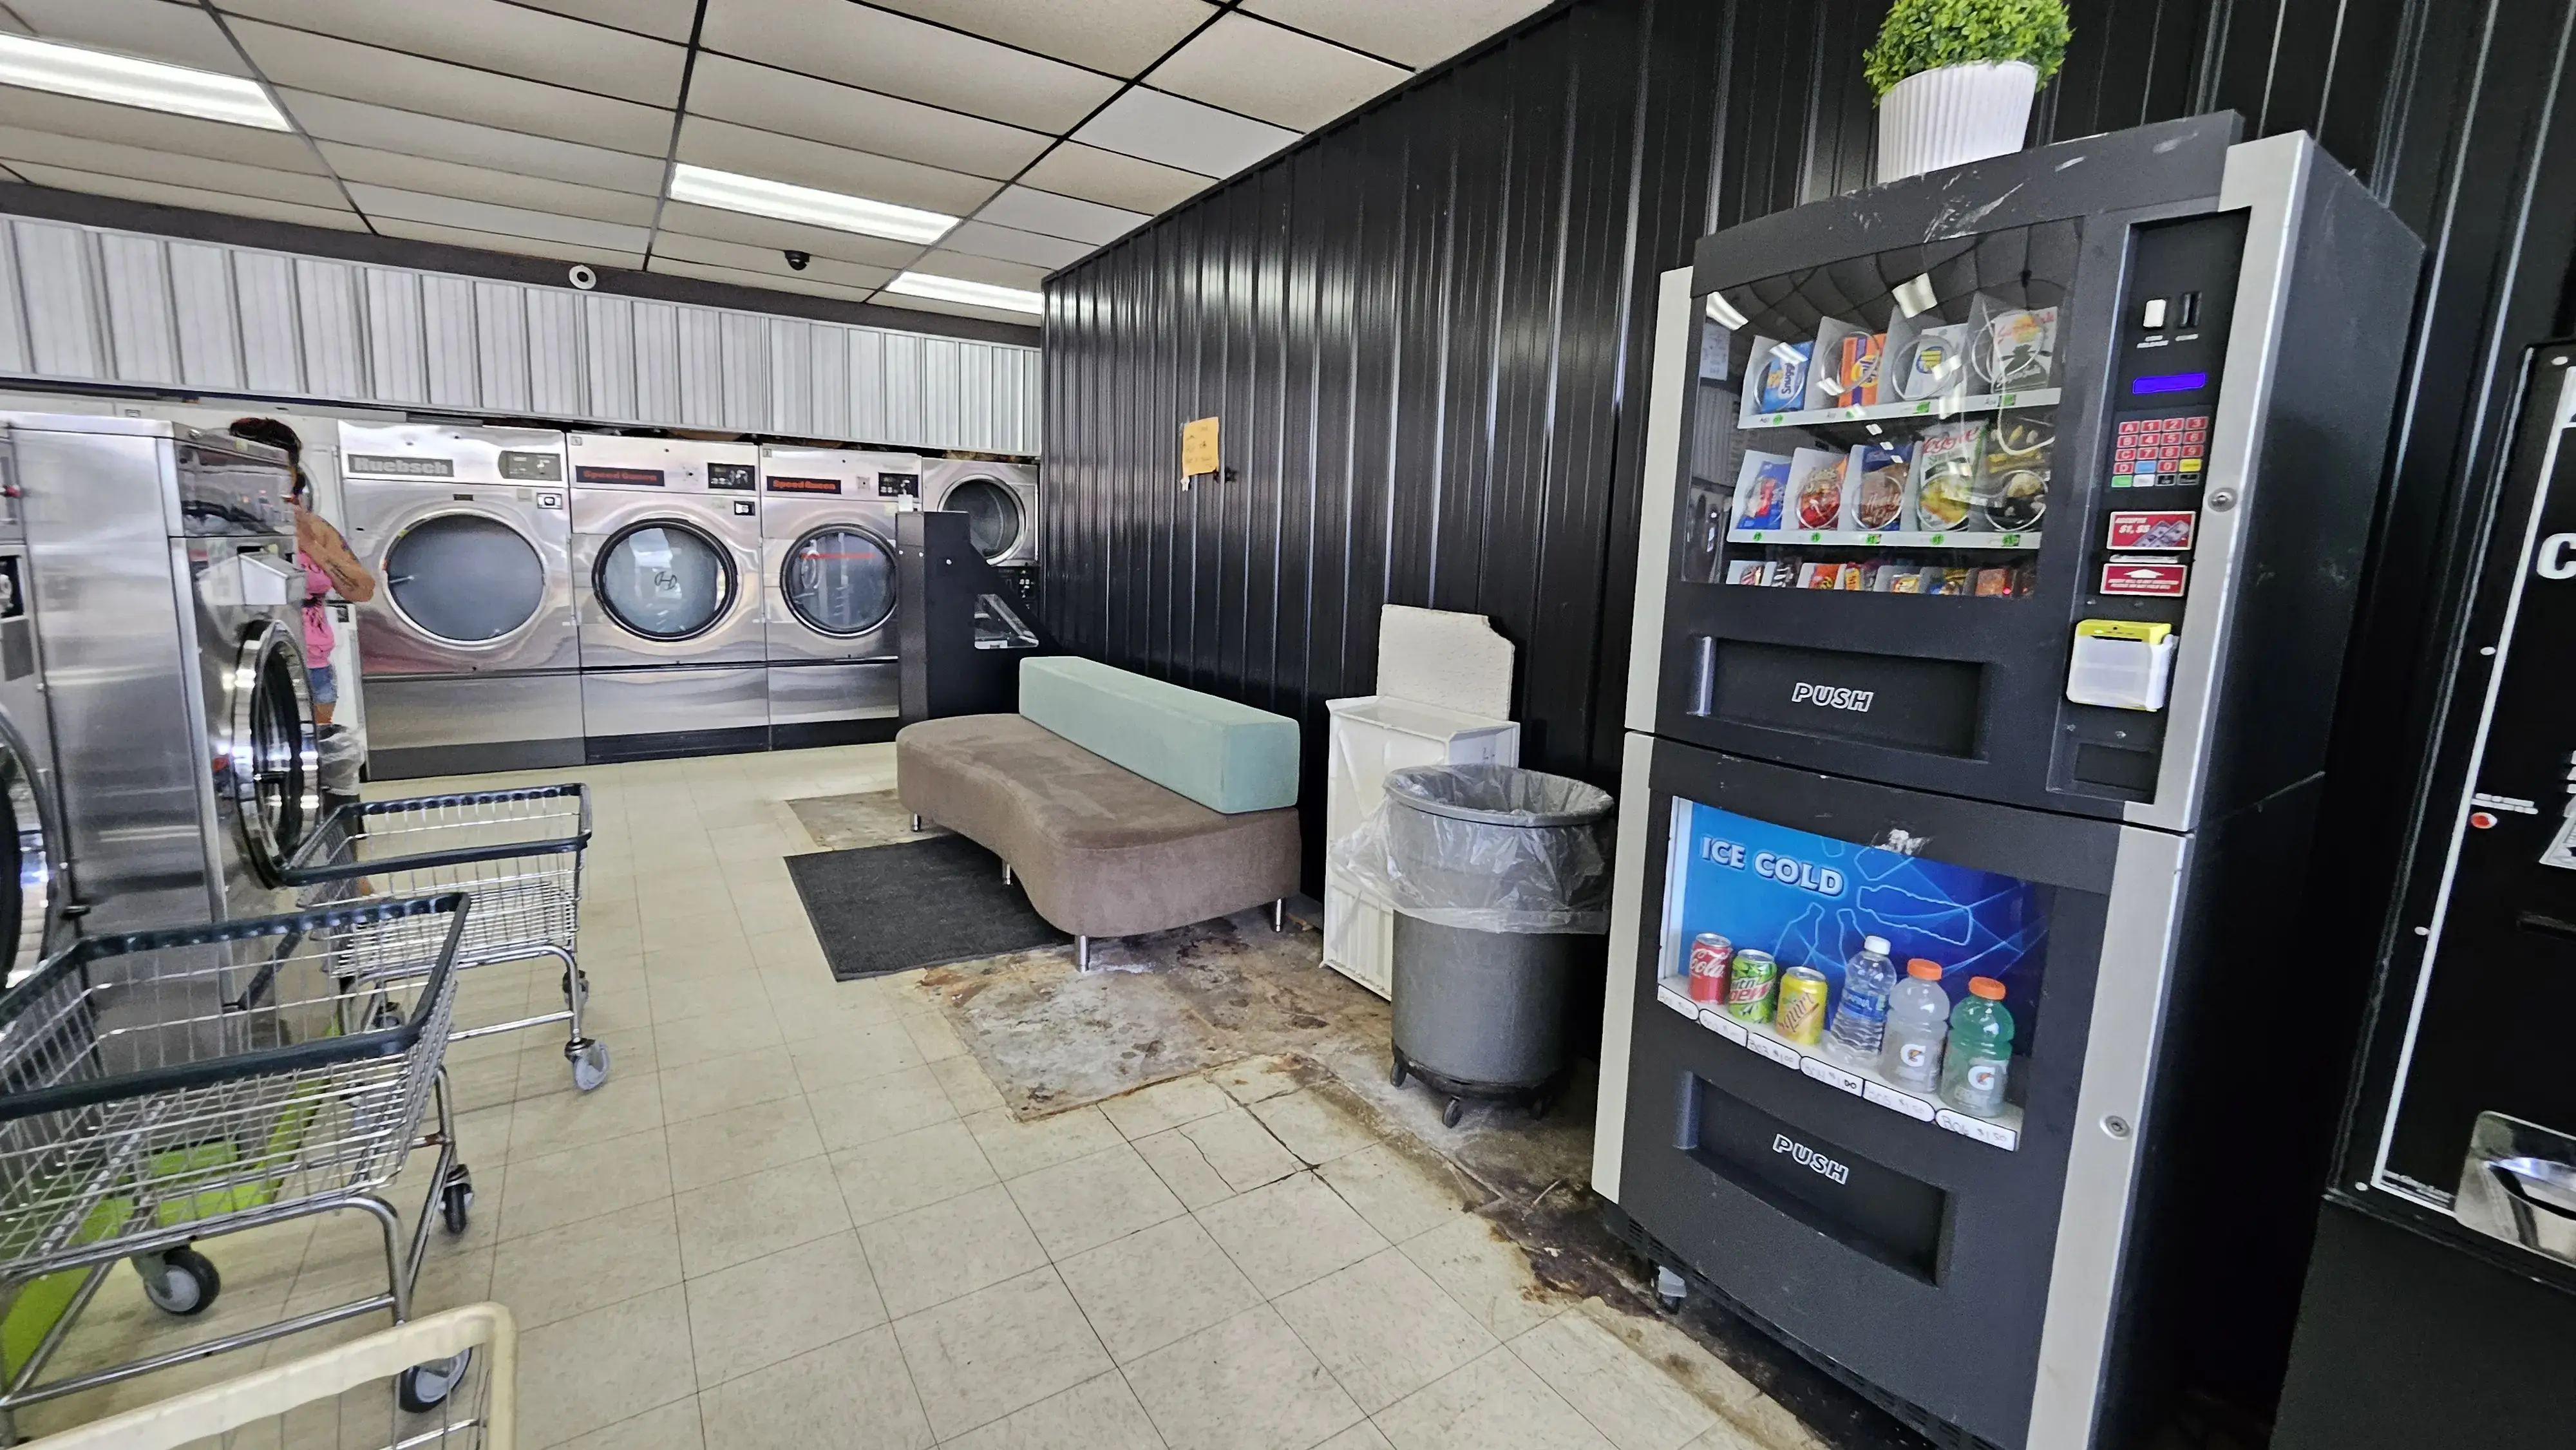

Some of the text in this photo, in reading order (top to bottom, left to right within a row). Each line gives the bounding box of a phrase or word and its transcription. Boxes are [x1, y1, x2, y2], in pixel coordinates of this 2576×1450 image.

[2192, 419, 2201, 428] 3
[2167, 435, 2175, 443] 5
[1791, 682, 1874, 712] PUSH
[1701, 836, 1844, 897] ICE COLD
[1900, 1044, 1926, 1067] G
[1967, 1066, 1996, 1091] G
[1772, 1133, 1849, 1185] PUSH
